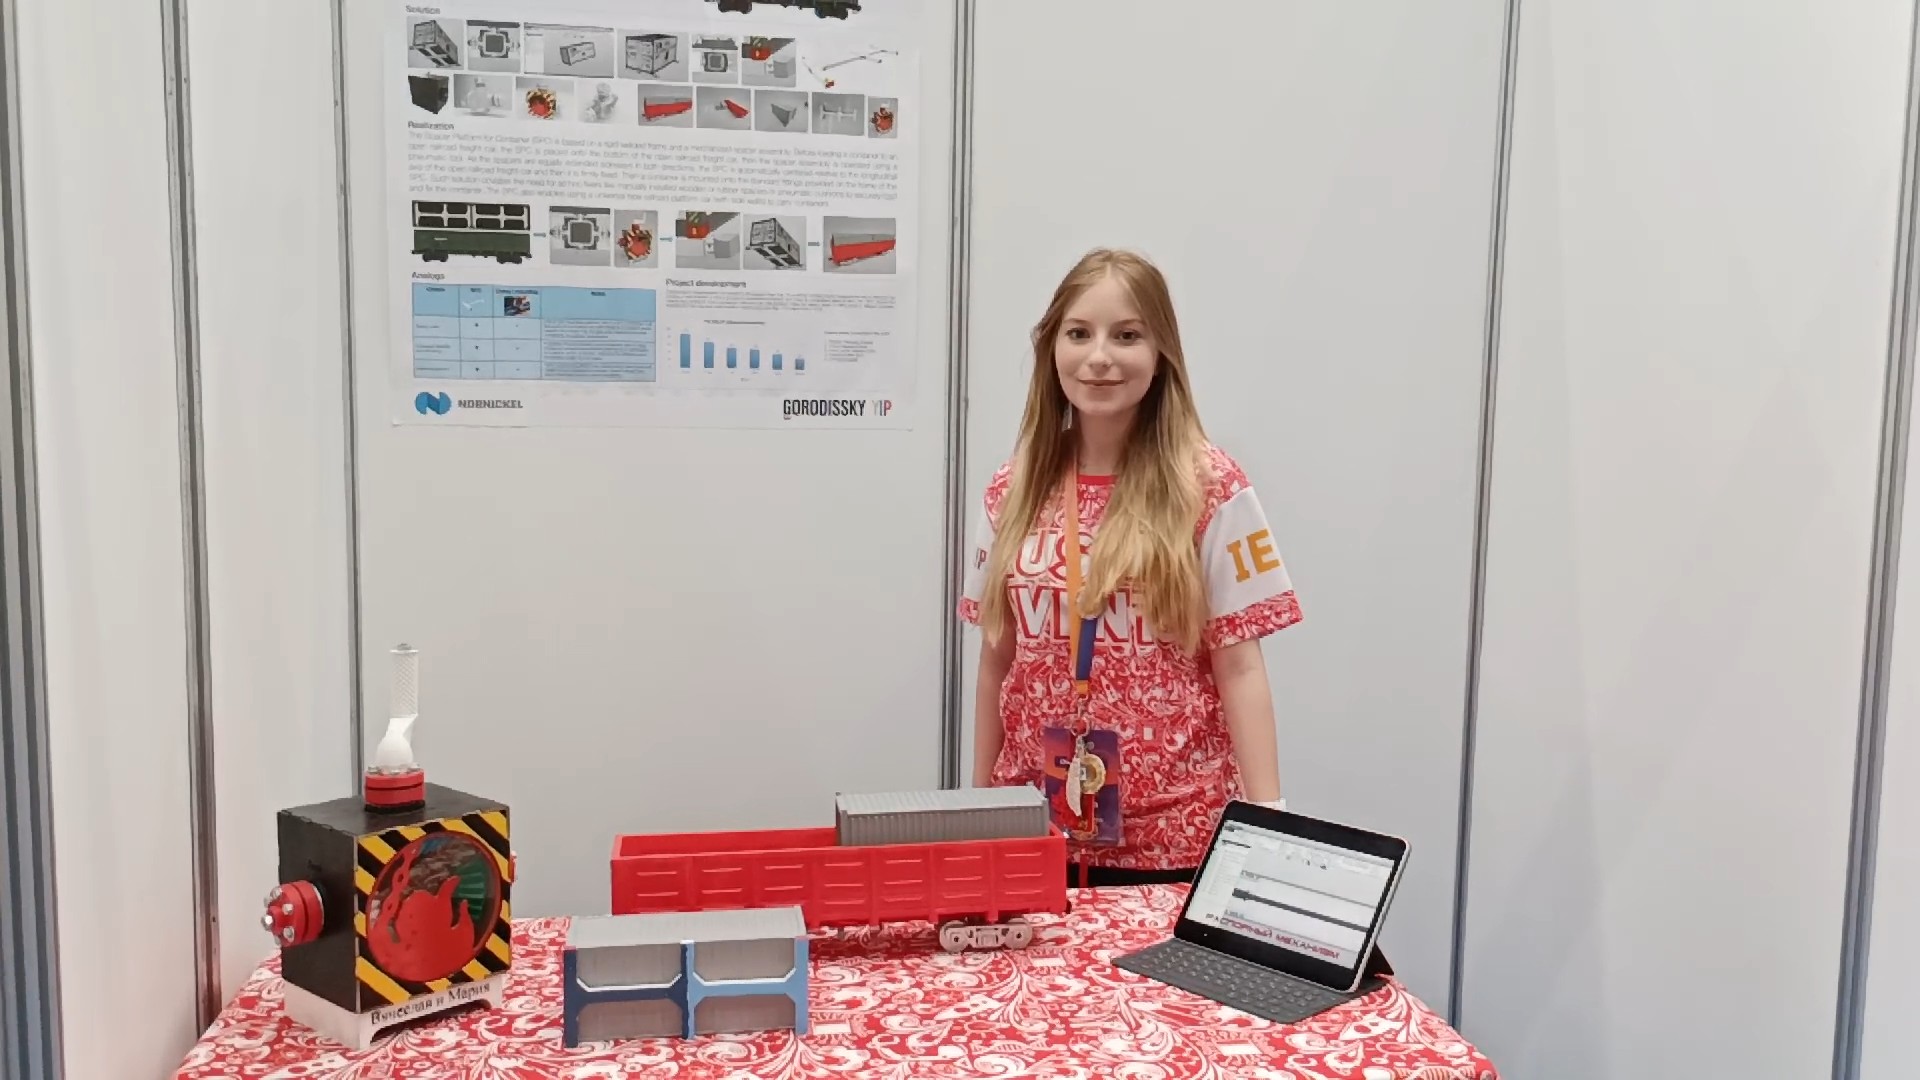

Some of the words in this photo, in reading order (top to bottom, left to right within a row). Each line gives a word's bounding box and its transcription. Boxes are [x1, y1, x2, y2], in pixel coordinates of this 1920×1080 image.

[458, 399, 524, 409] NORNICKEL
[783, 399, 866, 417] GORODISSKY
[872, 400, 892, 416] YIP
[1226, 529, 1281, 583] IE
[448, 982, 490, 1002] Мария
